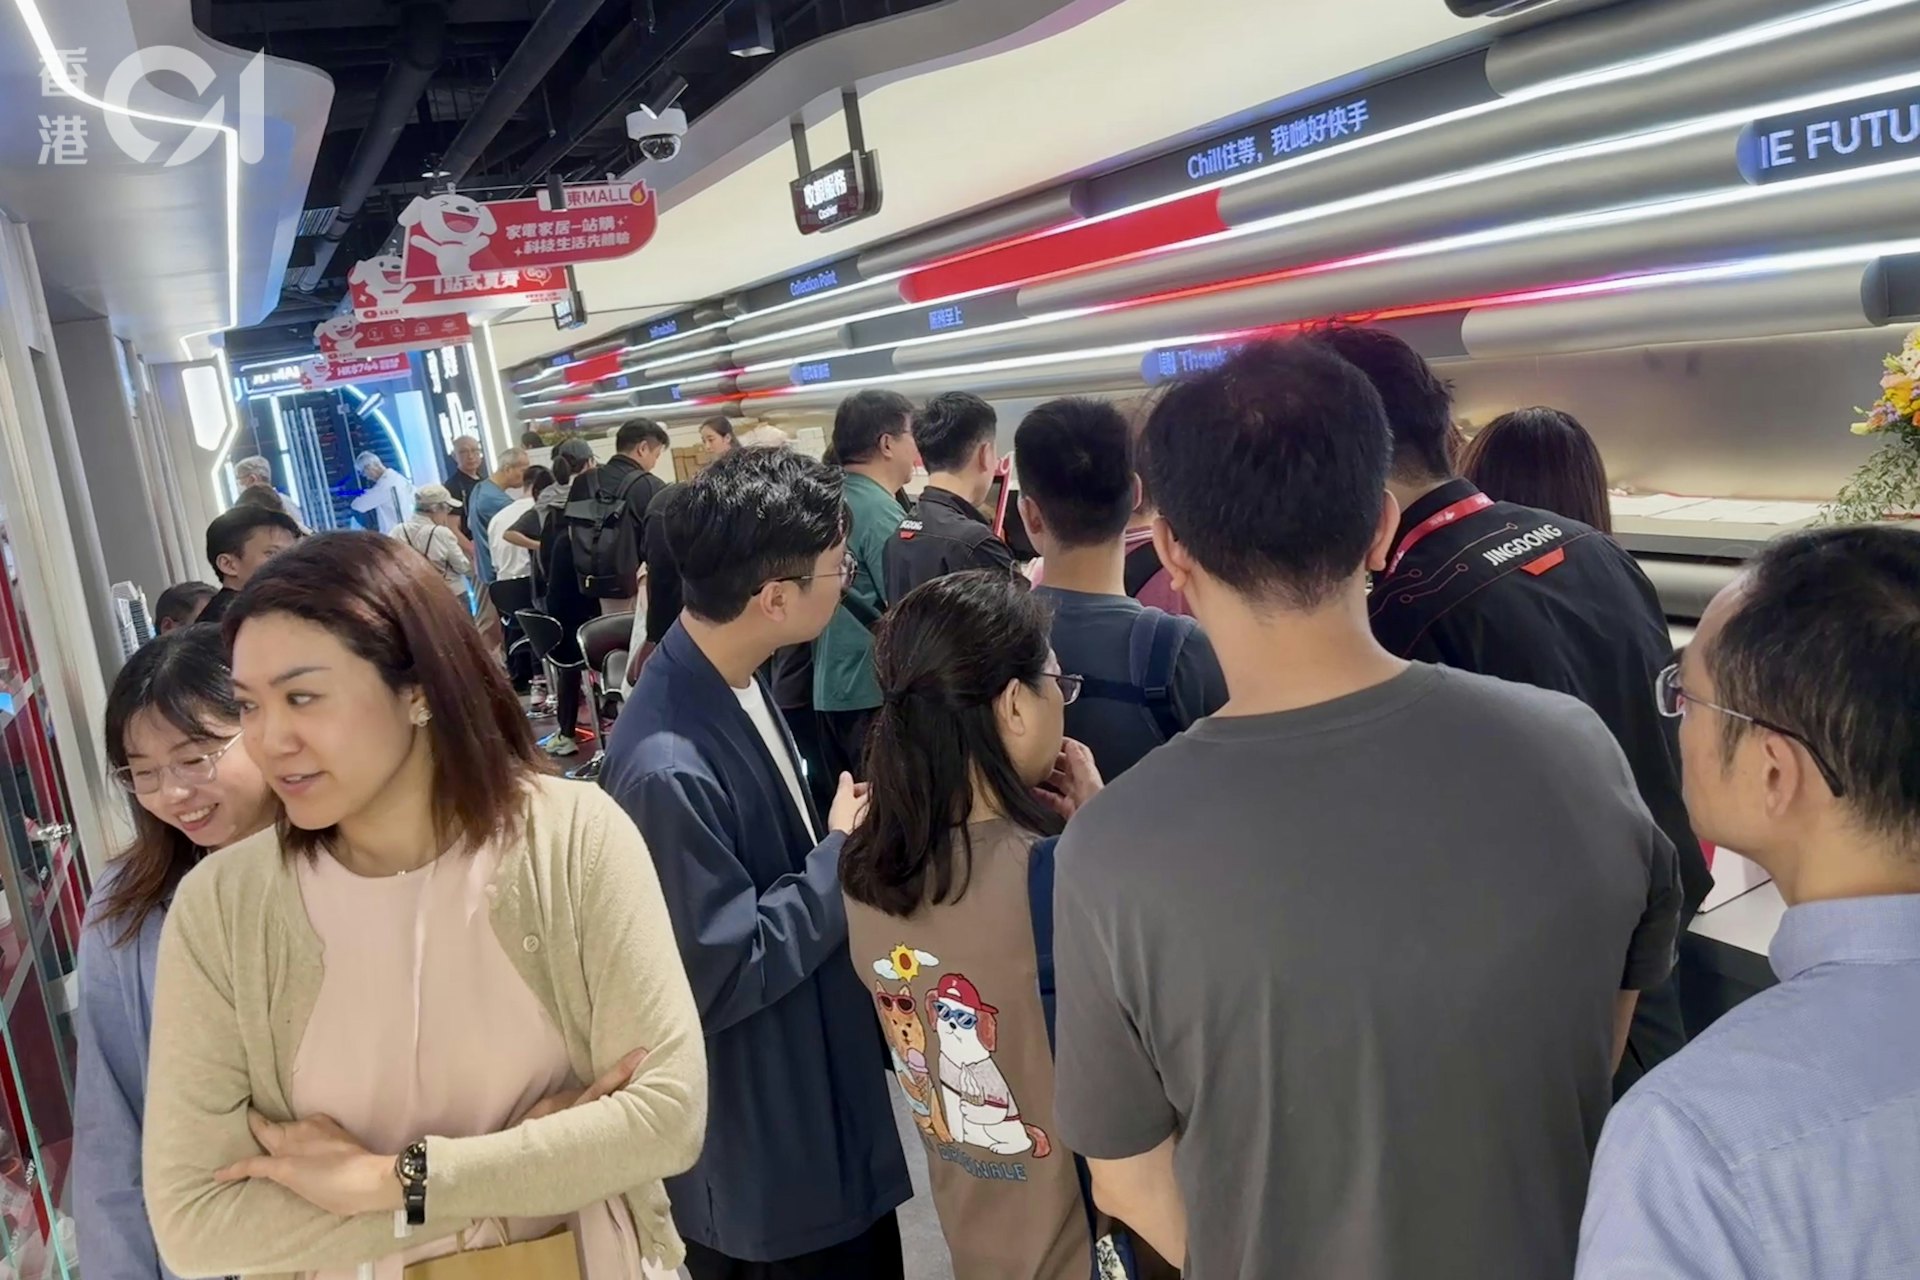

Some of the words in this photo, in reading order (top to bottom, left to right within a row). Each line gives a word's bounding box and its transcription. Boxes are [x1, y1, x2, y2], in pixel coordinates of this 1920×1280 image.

[1806, 104, 1920, 160] FUTU
[505, 216, 616, 240] 家電家居一站購
[523, 231, 631, 254] 科技生活先體驗
[790, 274, 819, 296] Collection
[819, 270, 837, 287] Point
[1482, 523, 1562, 566] JINGDONG
